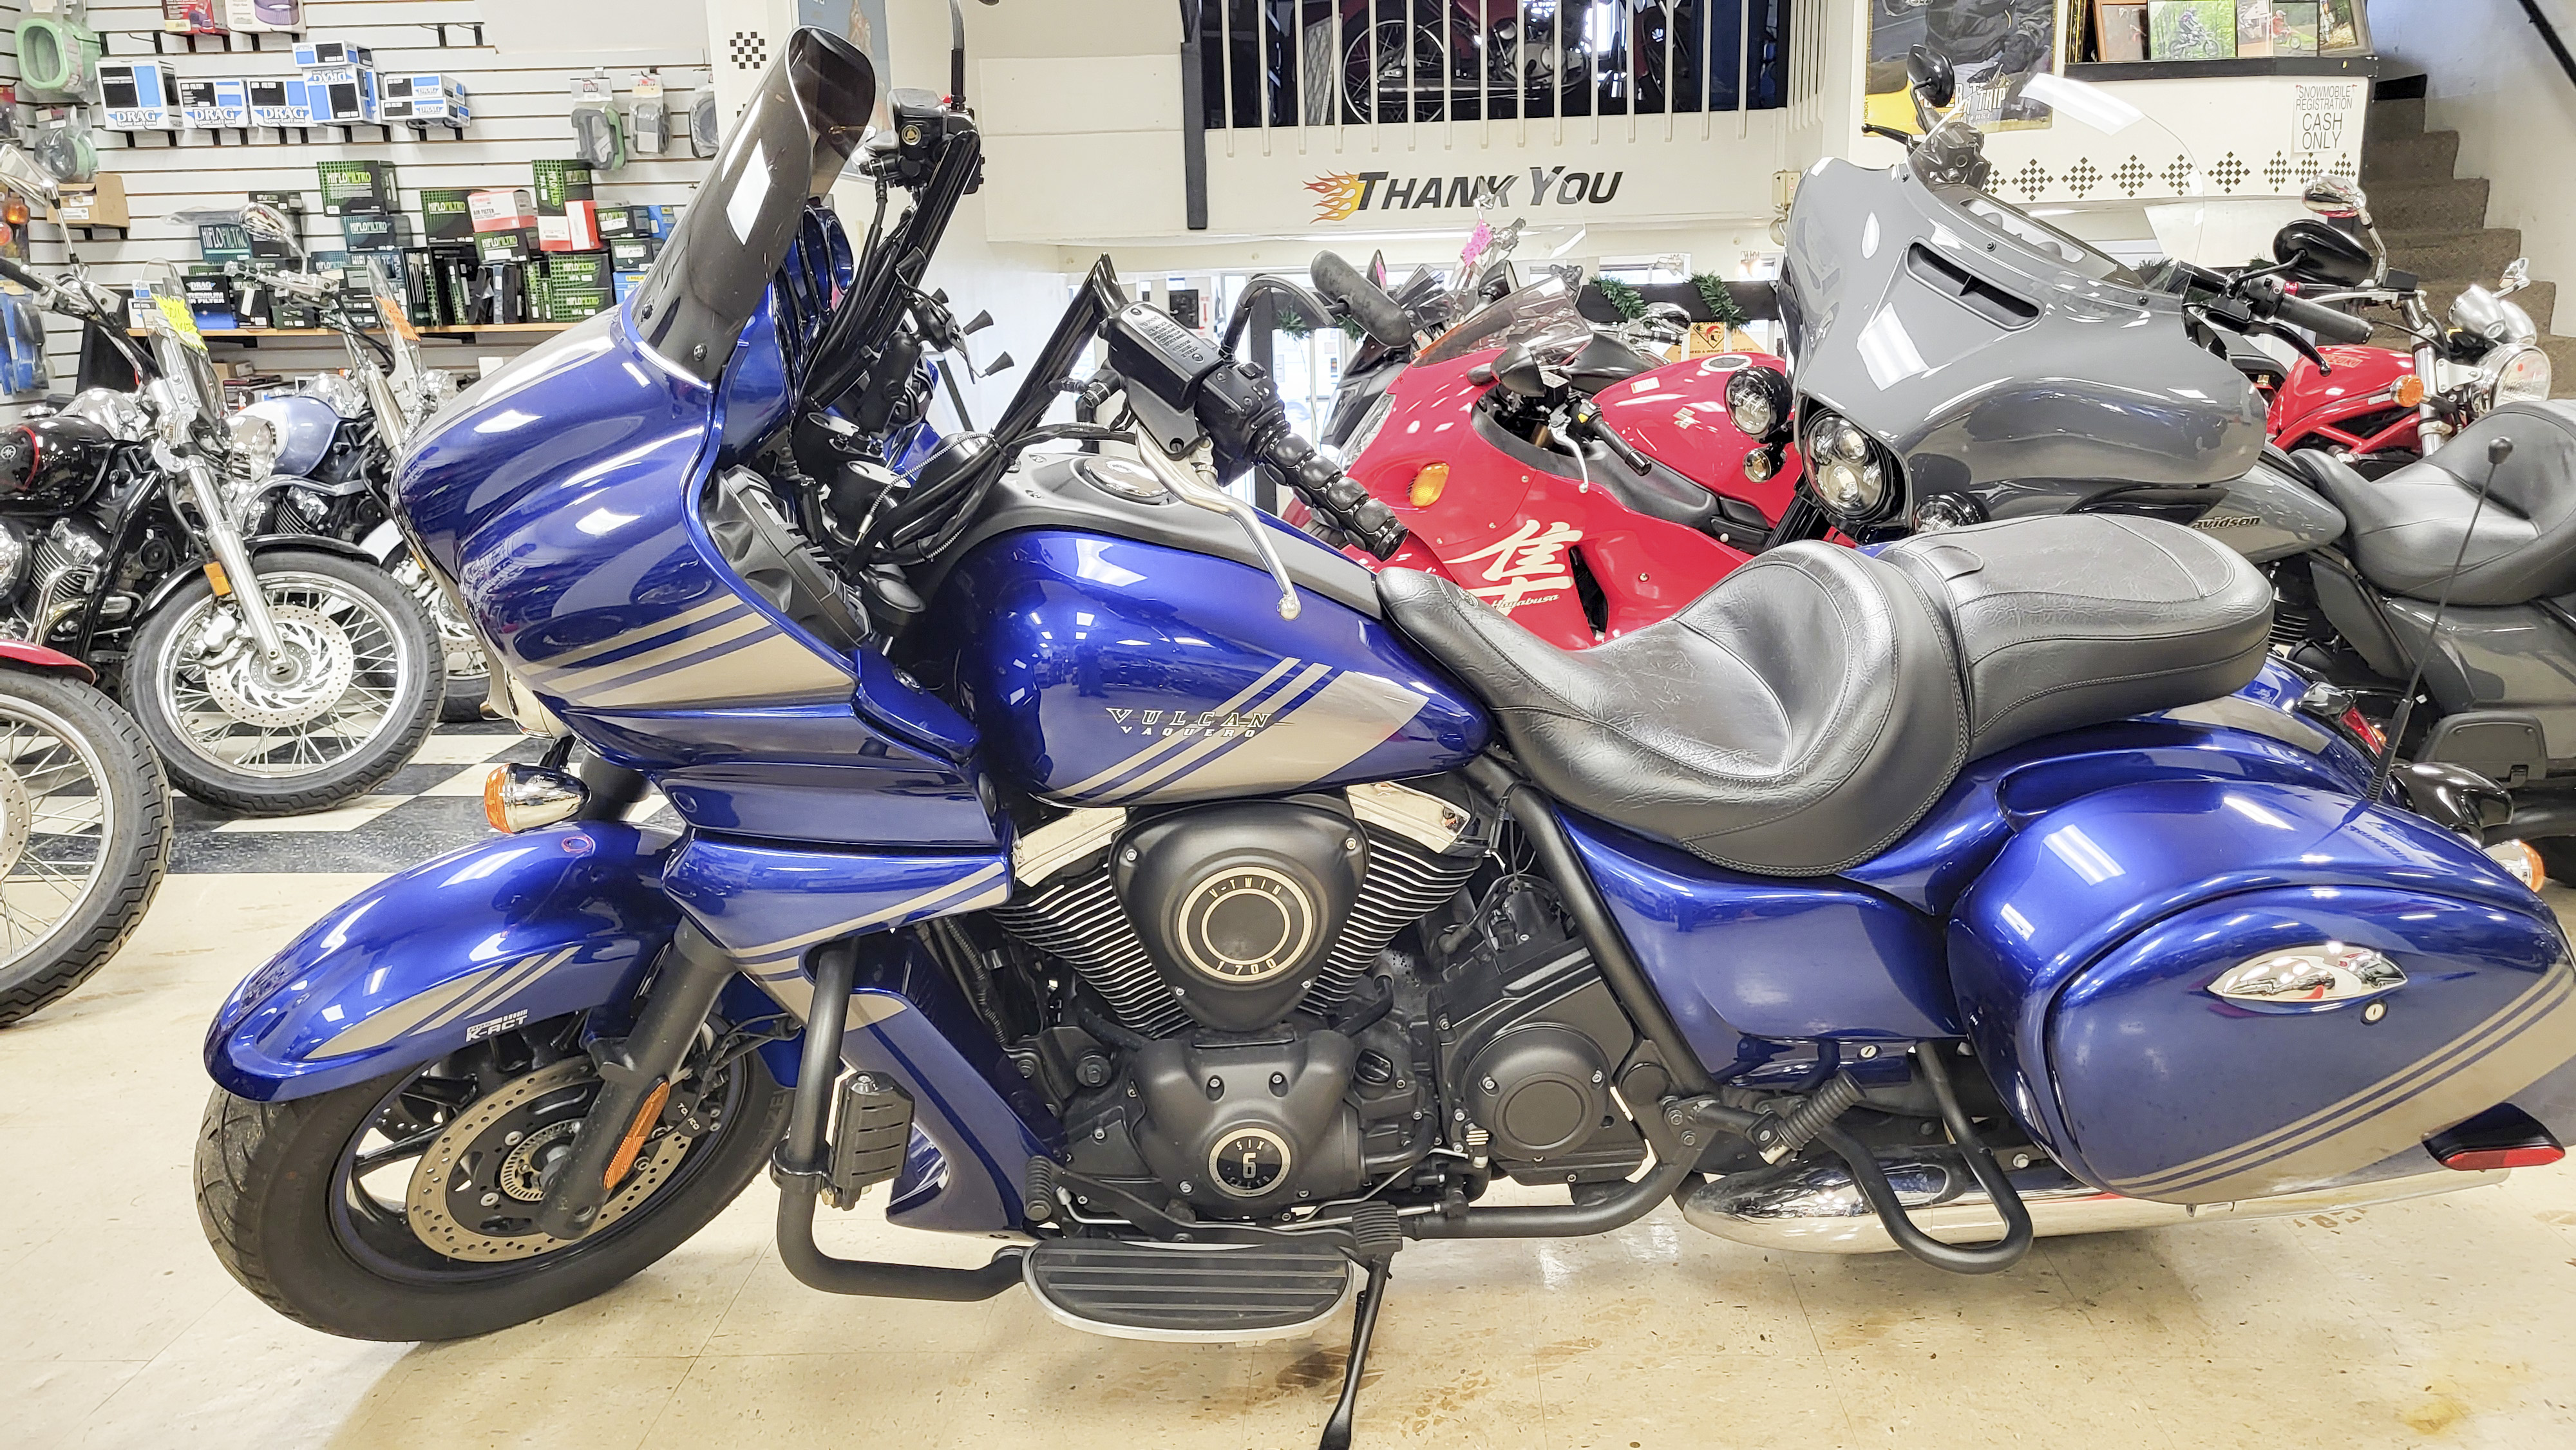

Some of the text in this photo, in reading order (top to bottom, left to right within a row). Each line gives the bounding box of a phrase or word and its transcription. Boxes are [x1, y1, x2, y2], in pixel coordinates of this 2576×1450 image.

[314, 71, 348, 83] DRAG
[2298, 86, 2351, 99] SNOWMOBILE
[2296, 98, 2353, 111] REGISTRATION
[116, 110, 156, 122] DRAG
[193, 108, 235, 120] DRAG
[262, 108, 305, 119] DRAG
[2302, 113, 2343, 131] CASH
[2302, 131, 2342, 150] ONLY
[327, 171, 372, 184] HIFLOFILTRO
[1357, 165, 1624, 210] THANK YOU
[191, 281, 212, 290] DRAG
[1443, 519, 1584, 617] 隼
[1491, 594, 1560, 610] Hayabusa
[1105, 707, 1273, 728] VULCAN
[1120, 726, 1256, 738] VAQUERO
[1208, 876, 1282, 898] V-TWIN
[1216, 957, 1277, 975] 1700
[466, 1015, 528, 1042] K-ACT
[677, 1102, 700, 1131] TOICO
[1236, 1138, 1265, 1151] SIX
[1242, 1152, 1256, 1179] 6
[1227, 1175, 1271, 1189] SPEED
